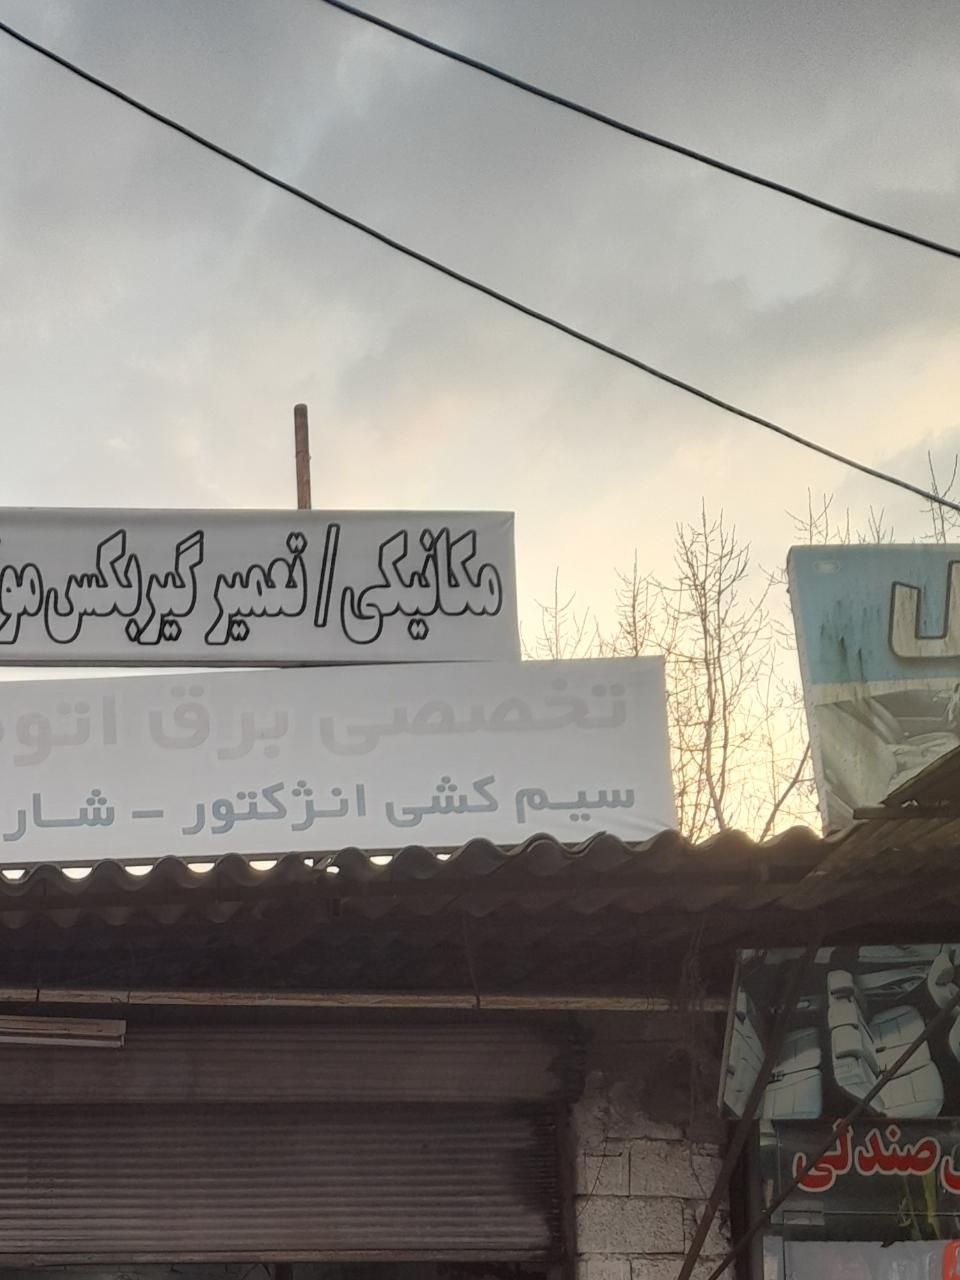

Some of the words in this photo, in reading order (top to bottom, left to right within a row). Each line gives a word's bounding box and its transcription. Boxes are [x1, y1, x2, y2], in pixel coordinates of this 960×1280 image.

[204, 531, 308, 645] تعمیر
[341, 527, 503, 645] مکانیکی
[148, 685, 289, 760] برق
[319, 678, 627, 757] تخصصی
[182, 780, 367, 836] انژکتور
[385, 775, 500, 828] کشی
[515, 786, 635, 824] سیم
[793, 1119, 941, 1192] صندلی
